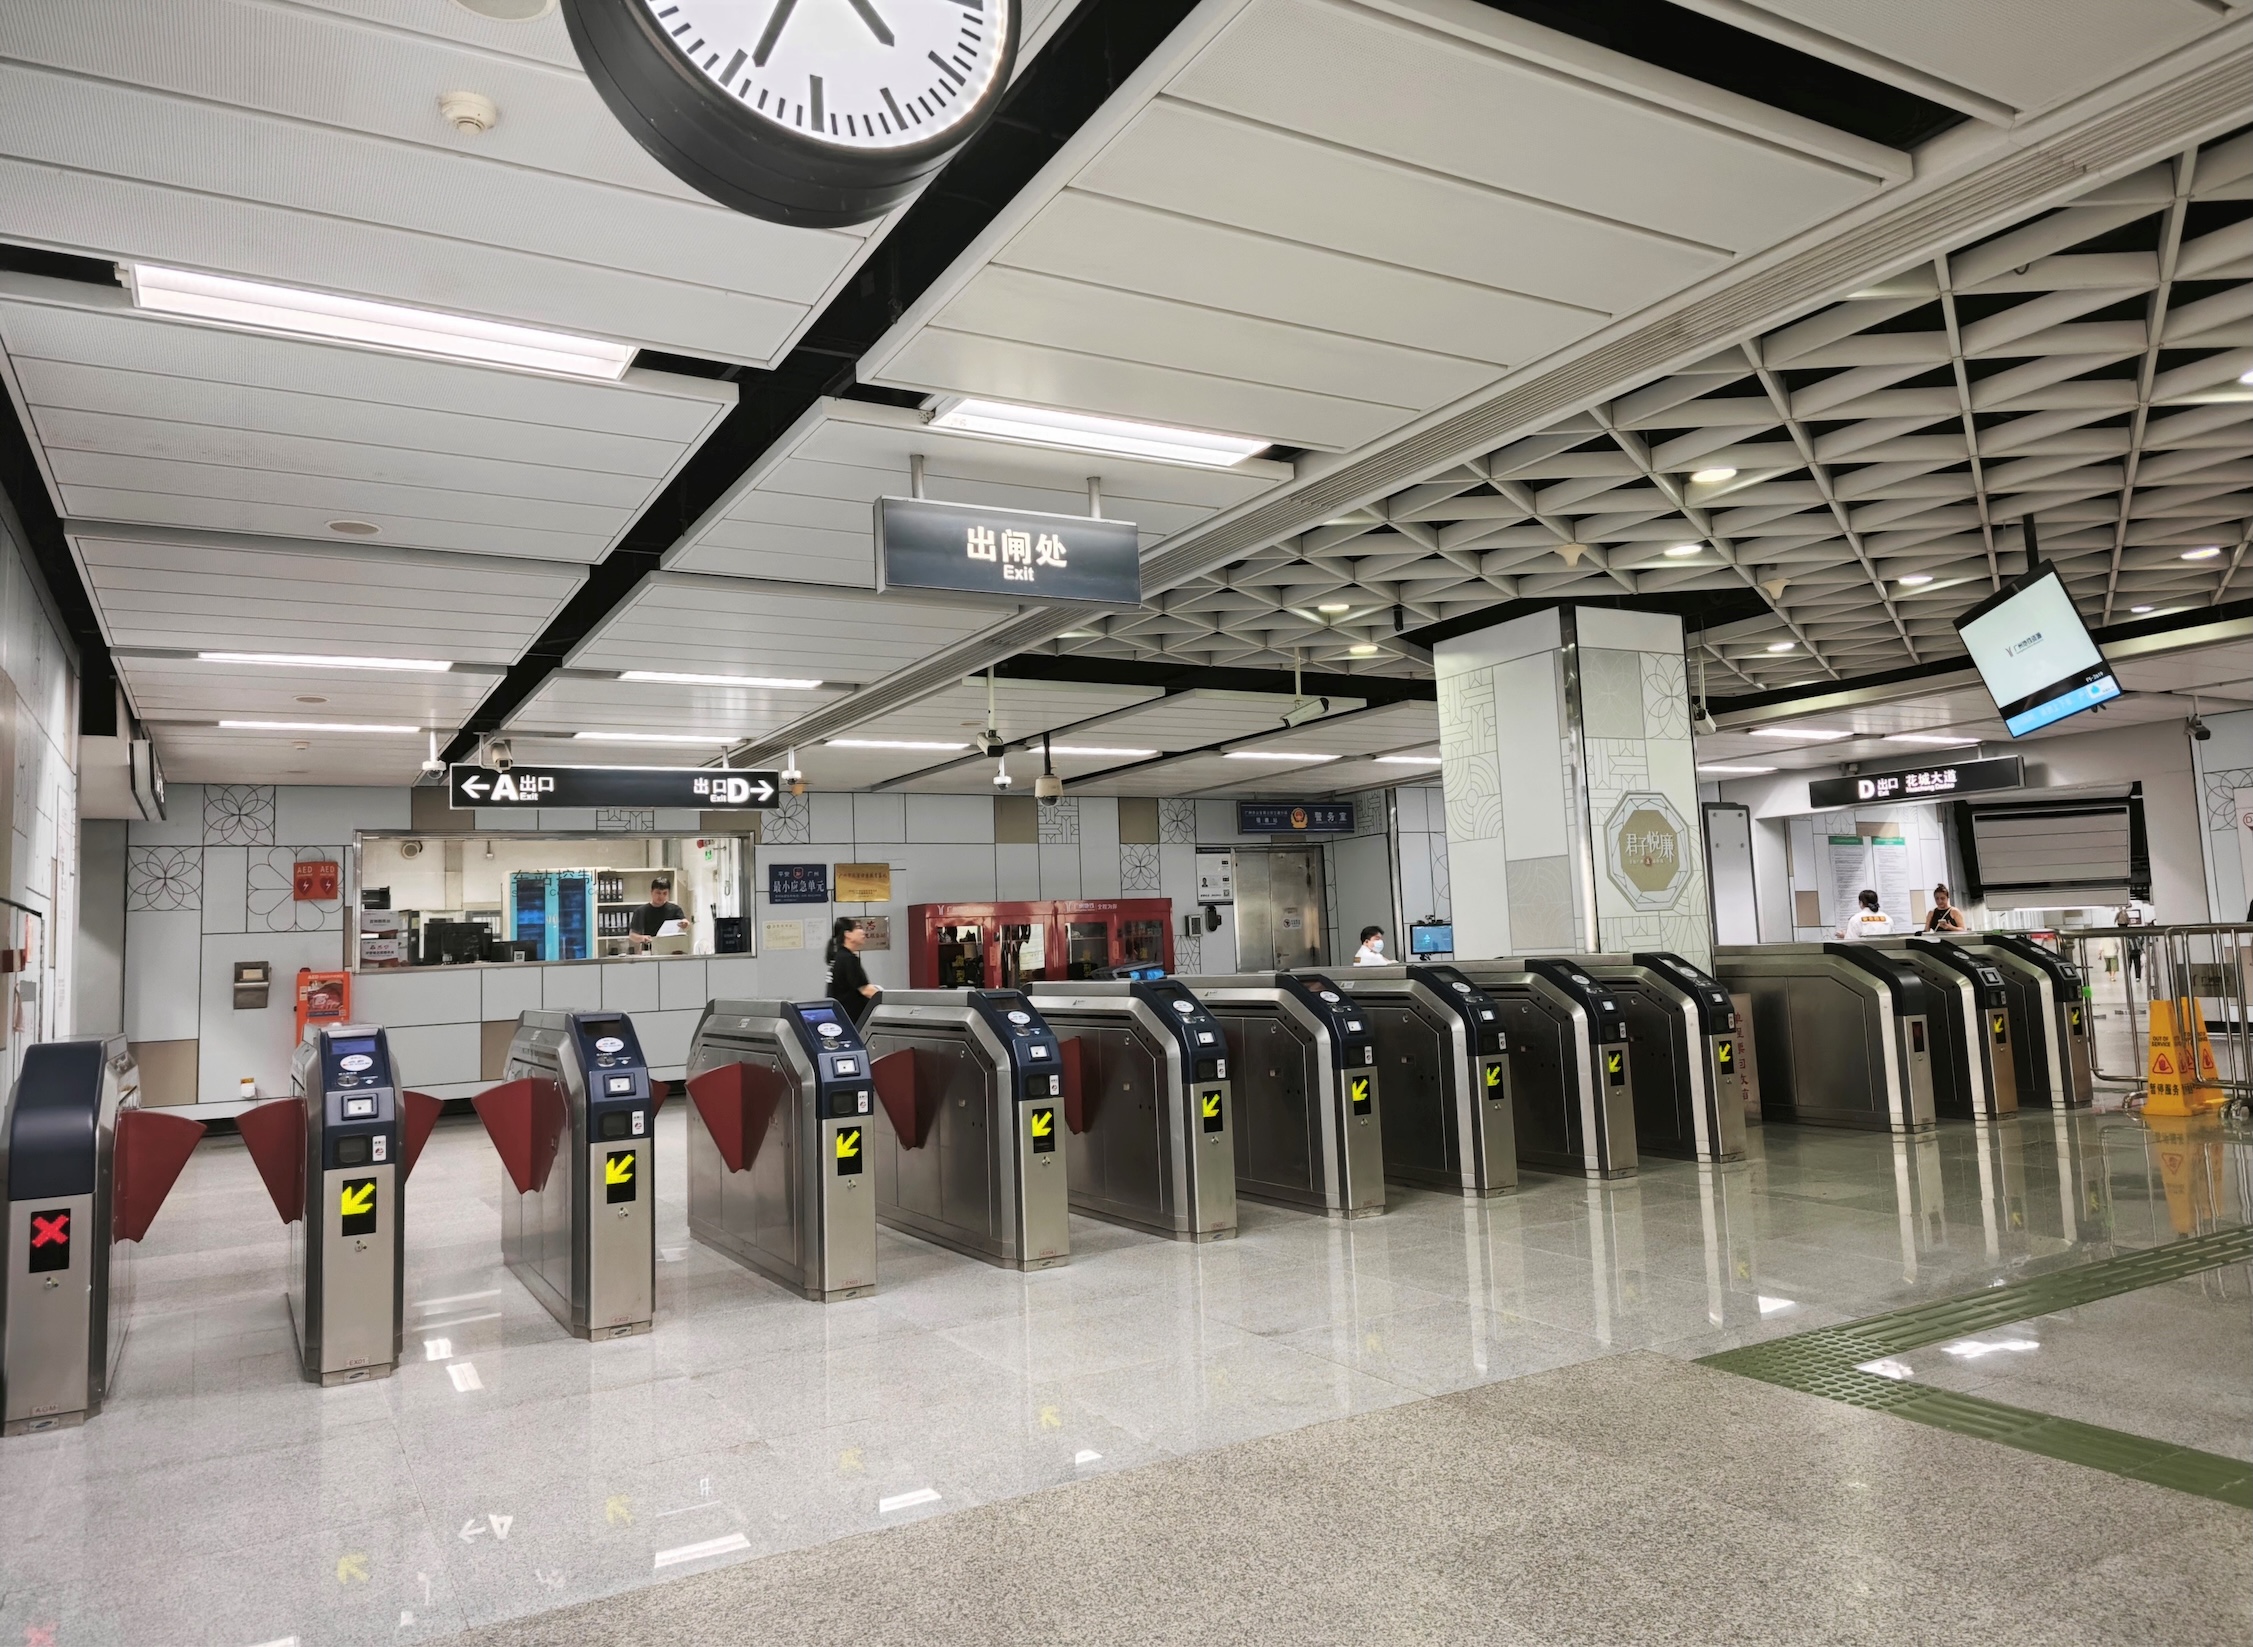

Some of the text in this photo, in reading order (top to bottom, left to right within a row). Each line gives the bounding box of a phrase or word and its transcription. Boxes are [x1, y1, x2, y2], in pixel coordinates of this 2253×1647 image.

[966, 525, 1068, 568] 出闸处
[1003, 564, 1035, 582] Exit
[490, 774, 555, 801] A 出口
[693, 777, 750, 804] 出口 D
[1858, 769, 1958, 799] D 出口 花城大道
[519, 792, 539, 801] Exit
[709, 794, 727, 803] Exit
[1314, 811, 1348, 822] 警务室
[1625, 830, 1675, 863] 君子悦廉
[297, 866, 313, 874] AED
[320, 865, 335, 873] AED
[773, 880, 825, 893] 最小应急单元
[2150, 1082, 2180, 1096] 暂停服务
